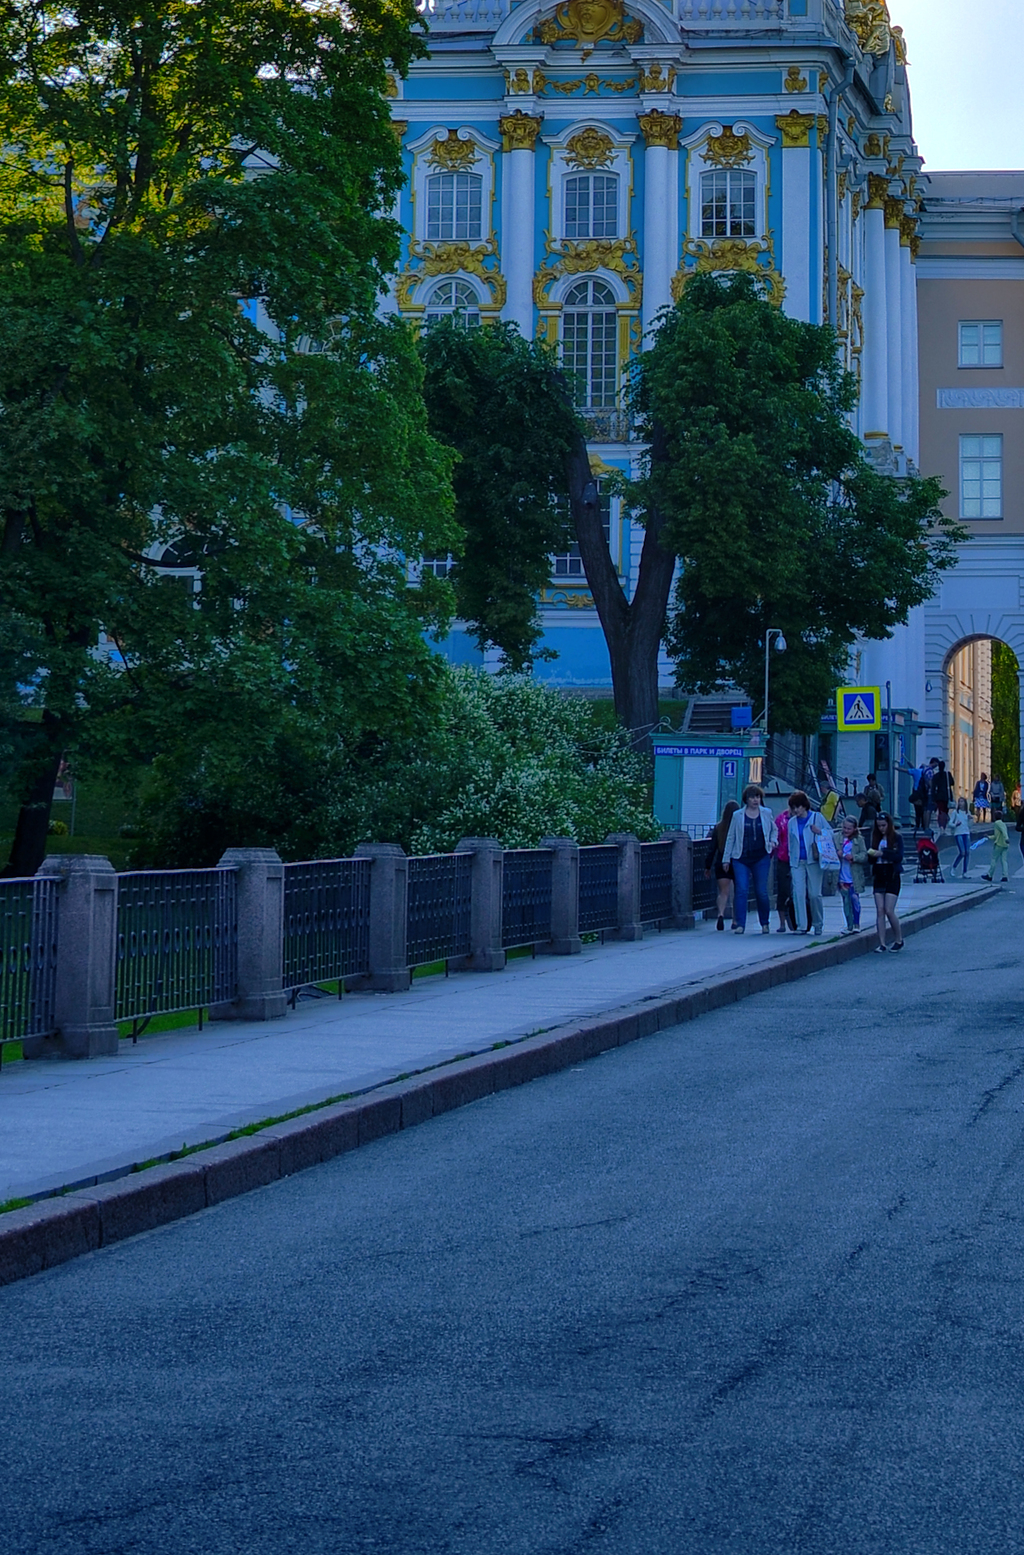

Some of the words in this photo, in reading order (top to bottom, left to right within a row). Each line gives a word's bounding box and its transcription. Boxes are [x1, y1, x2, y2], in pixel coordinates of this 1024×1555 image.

[879, 736, 886, 747] 2
[715, 748, 742, 756] ДВОРЕЦ
[726, 762, 734, 776] 1
